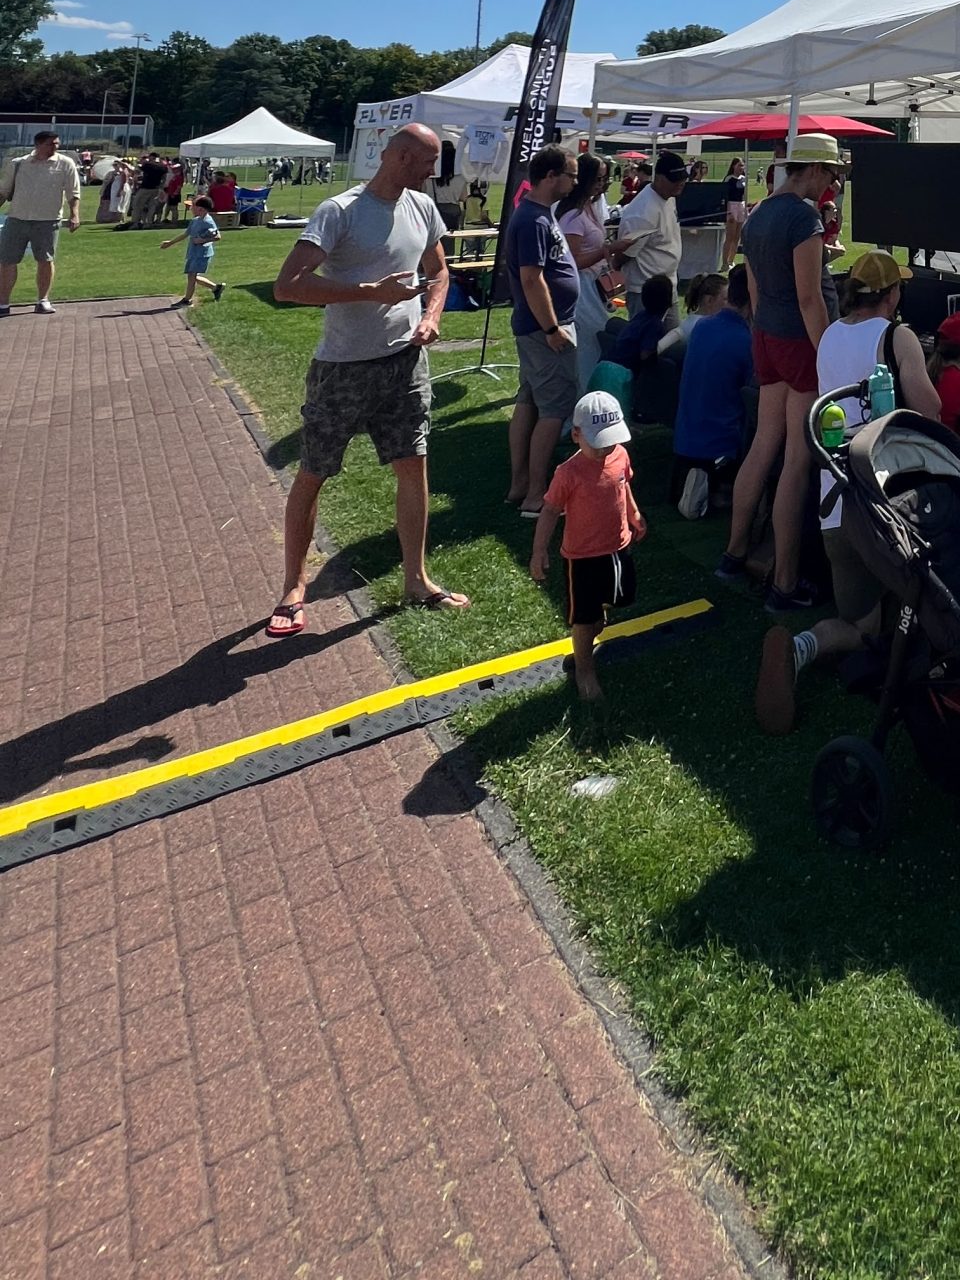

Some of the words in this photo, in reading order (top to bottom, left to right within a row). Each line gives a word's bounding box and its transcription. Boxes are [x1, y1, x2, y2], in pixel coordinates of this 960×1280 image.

[359, 103, 413, 124] FLYER
[592, 411, 620, 425] DUDE
[899, 605, 912, 634] Joie
